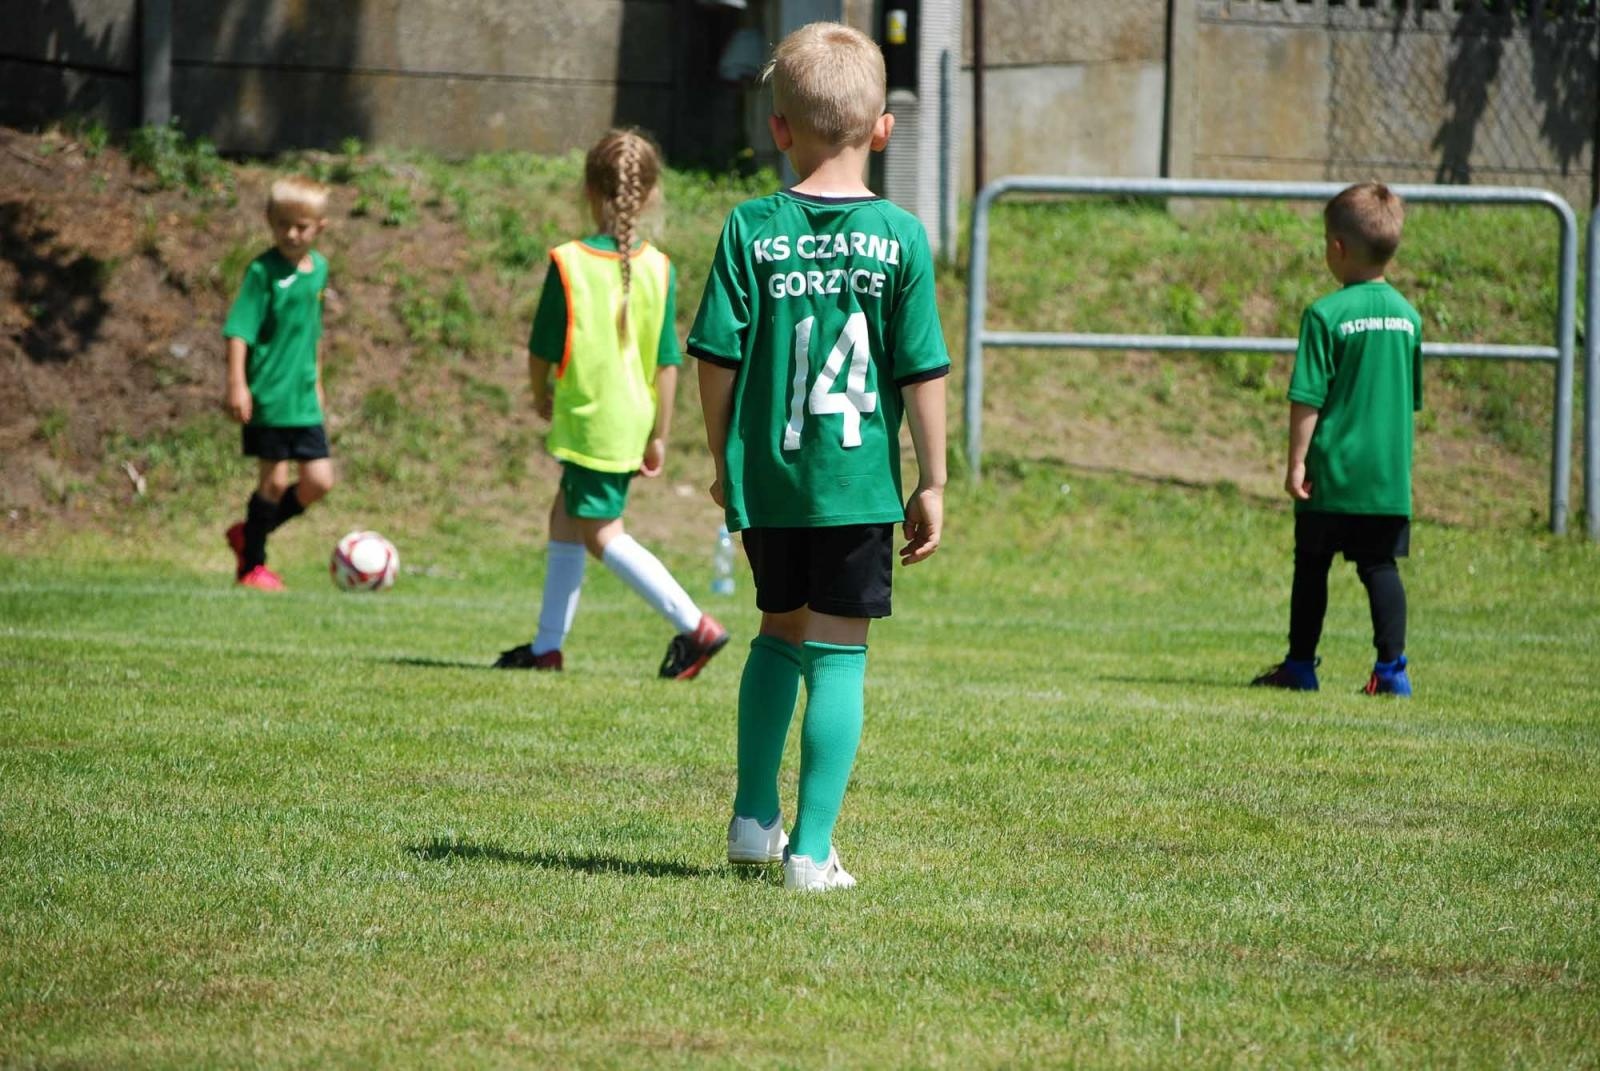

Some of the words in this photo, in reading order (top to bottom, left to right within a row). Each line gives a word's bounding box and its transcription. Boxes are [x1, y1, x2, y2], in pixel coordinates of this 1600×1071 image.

[753, 235, 790, 264] KS
[797, 232, 899, 265] CZARNI
[783, 312, 877, 451] 14
